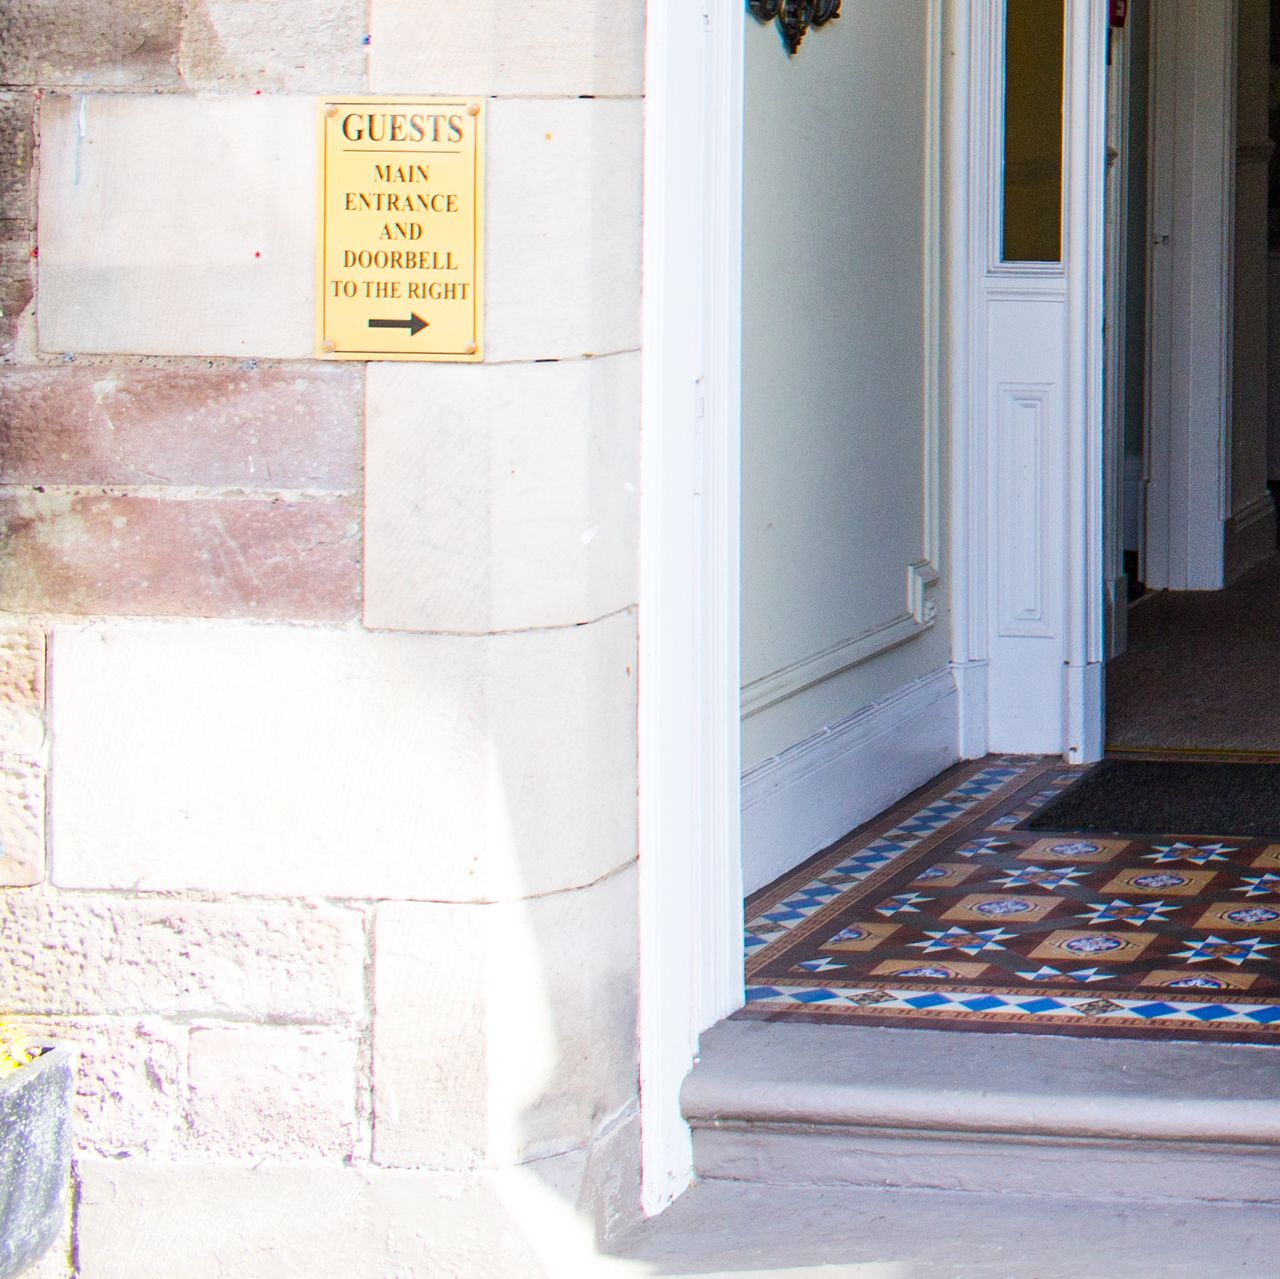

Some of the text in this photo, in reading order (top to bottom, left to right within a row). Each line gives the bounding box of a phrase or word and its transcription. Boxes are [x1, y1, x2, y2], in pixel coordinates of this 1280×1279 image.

[341, 113, 464, 143] GUESTS
[374, 164, 430, 183] MAIN
[344, 192, 458, 213] ENTRANCE
[379, 222, 423, 241] AND
[343, 249, 459, 270] DOORBELL
[331, 280, 470, 300] TO THE RIGHT
